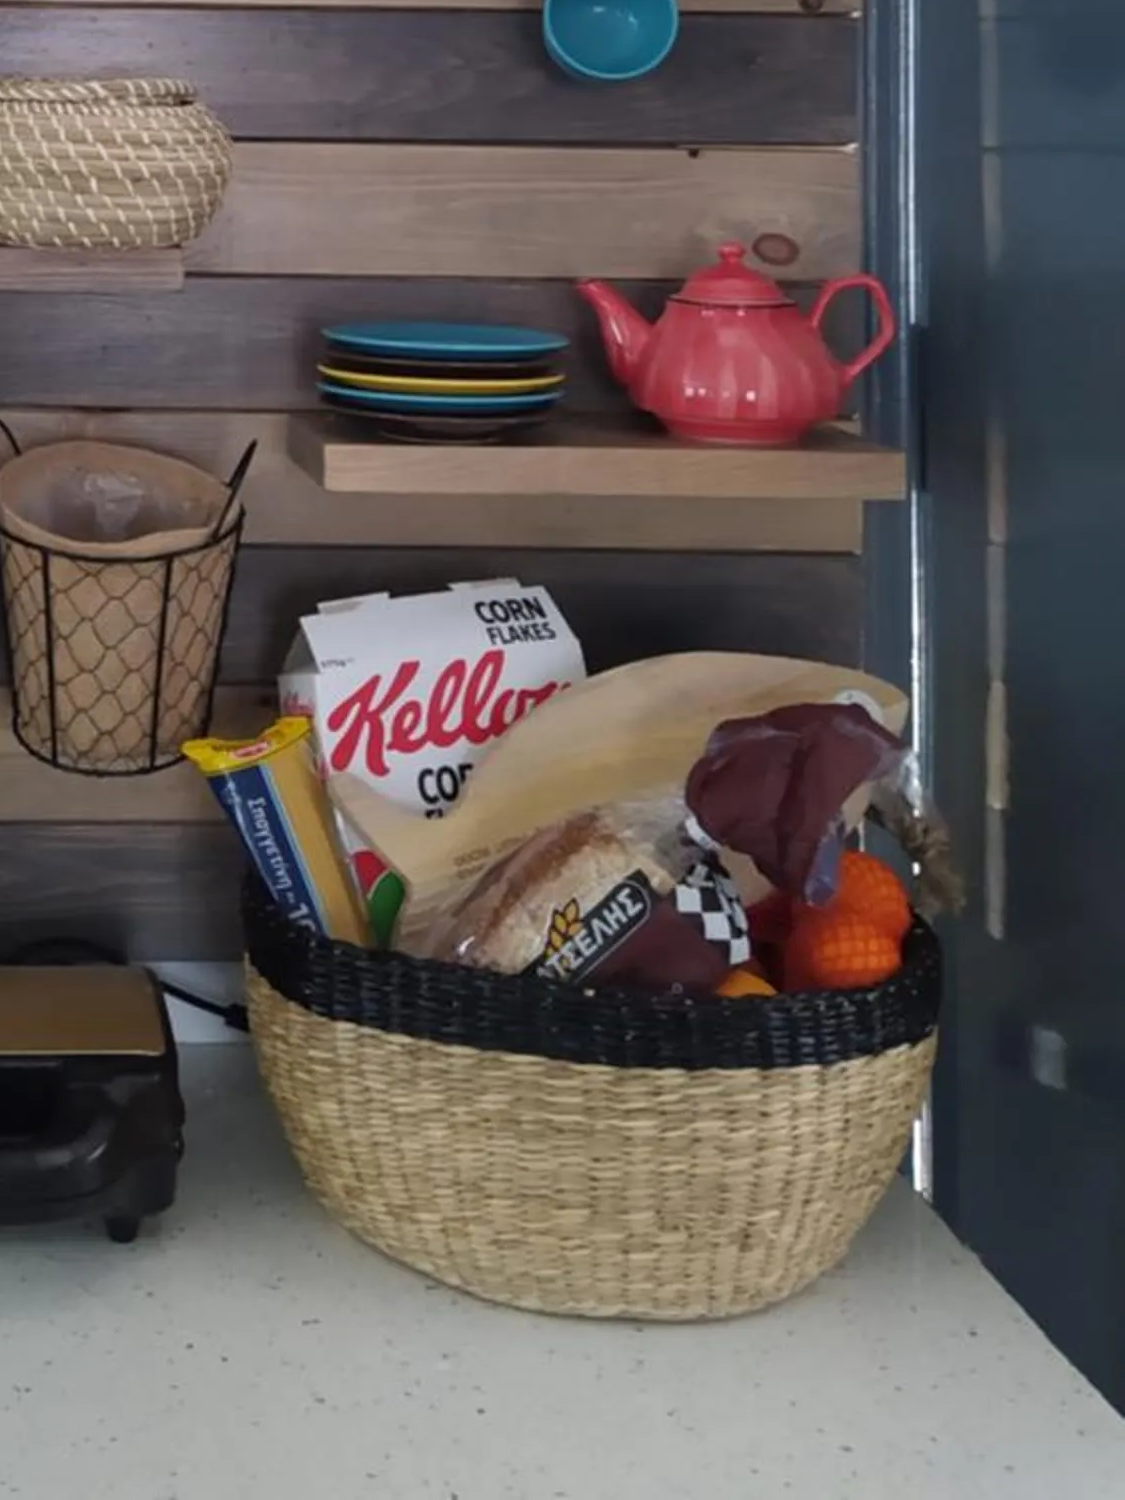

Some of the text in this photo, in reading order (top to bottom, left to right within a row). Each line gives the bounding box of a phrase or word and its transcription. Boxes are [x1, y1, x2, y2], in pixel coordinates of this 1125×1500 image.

[475, 596, 548, 624] CORN
[486, 622, 557, 646] FLAKES
[327, 649, 572, 777] Kello
